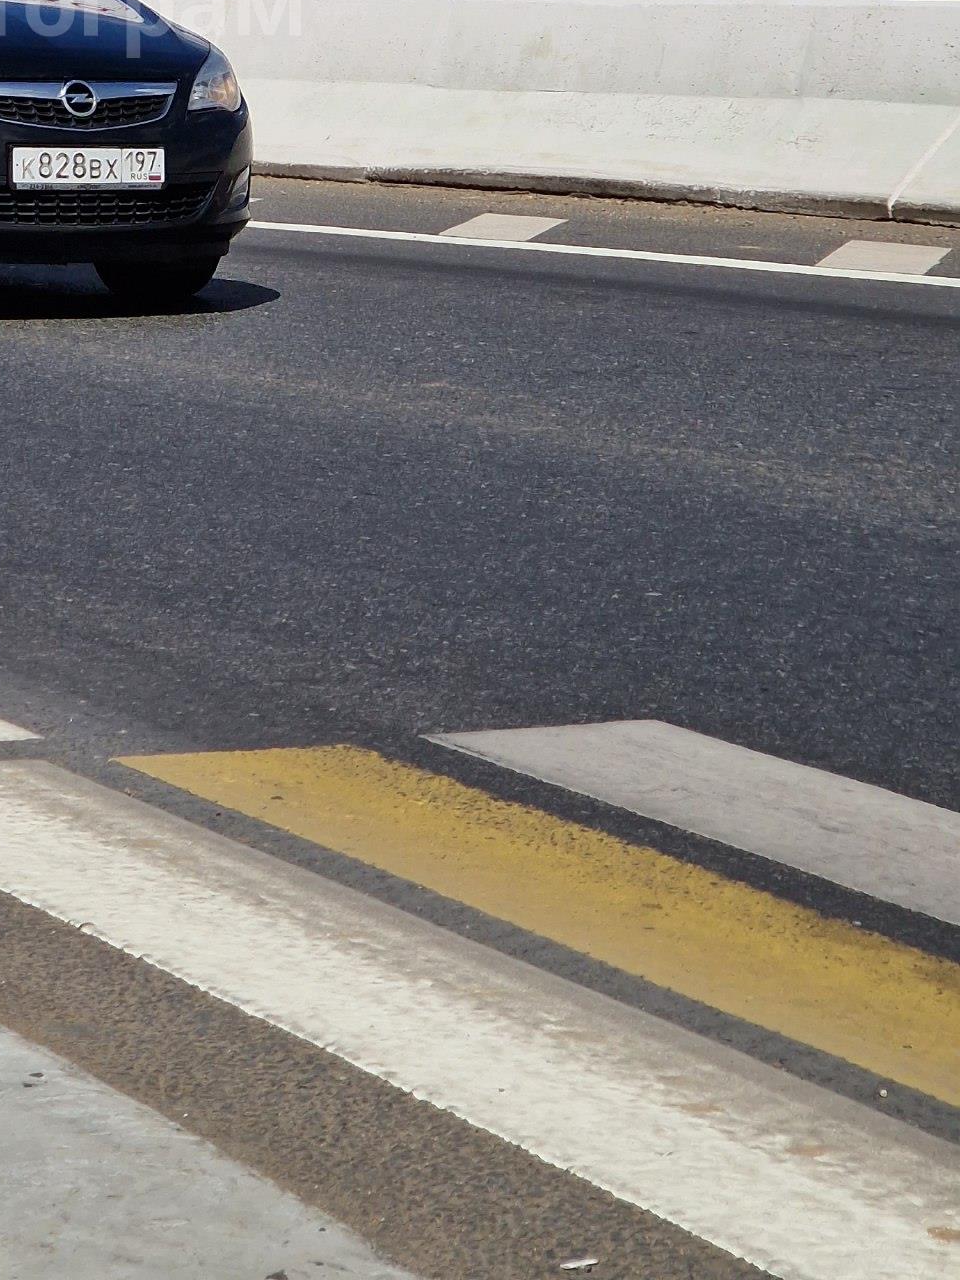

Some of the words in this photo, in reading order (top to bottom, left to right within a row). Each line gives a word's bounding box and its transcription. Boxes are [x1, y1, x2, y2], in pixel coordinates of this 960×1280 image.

[21, 152, 119, 180] К828ВХ
[124, 151, 158, 172] 197
[130, 172, 148, 181] RUS
